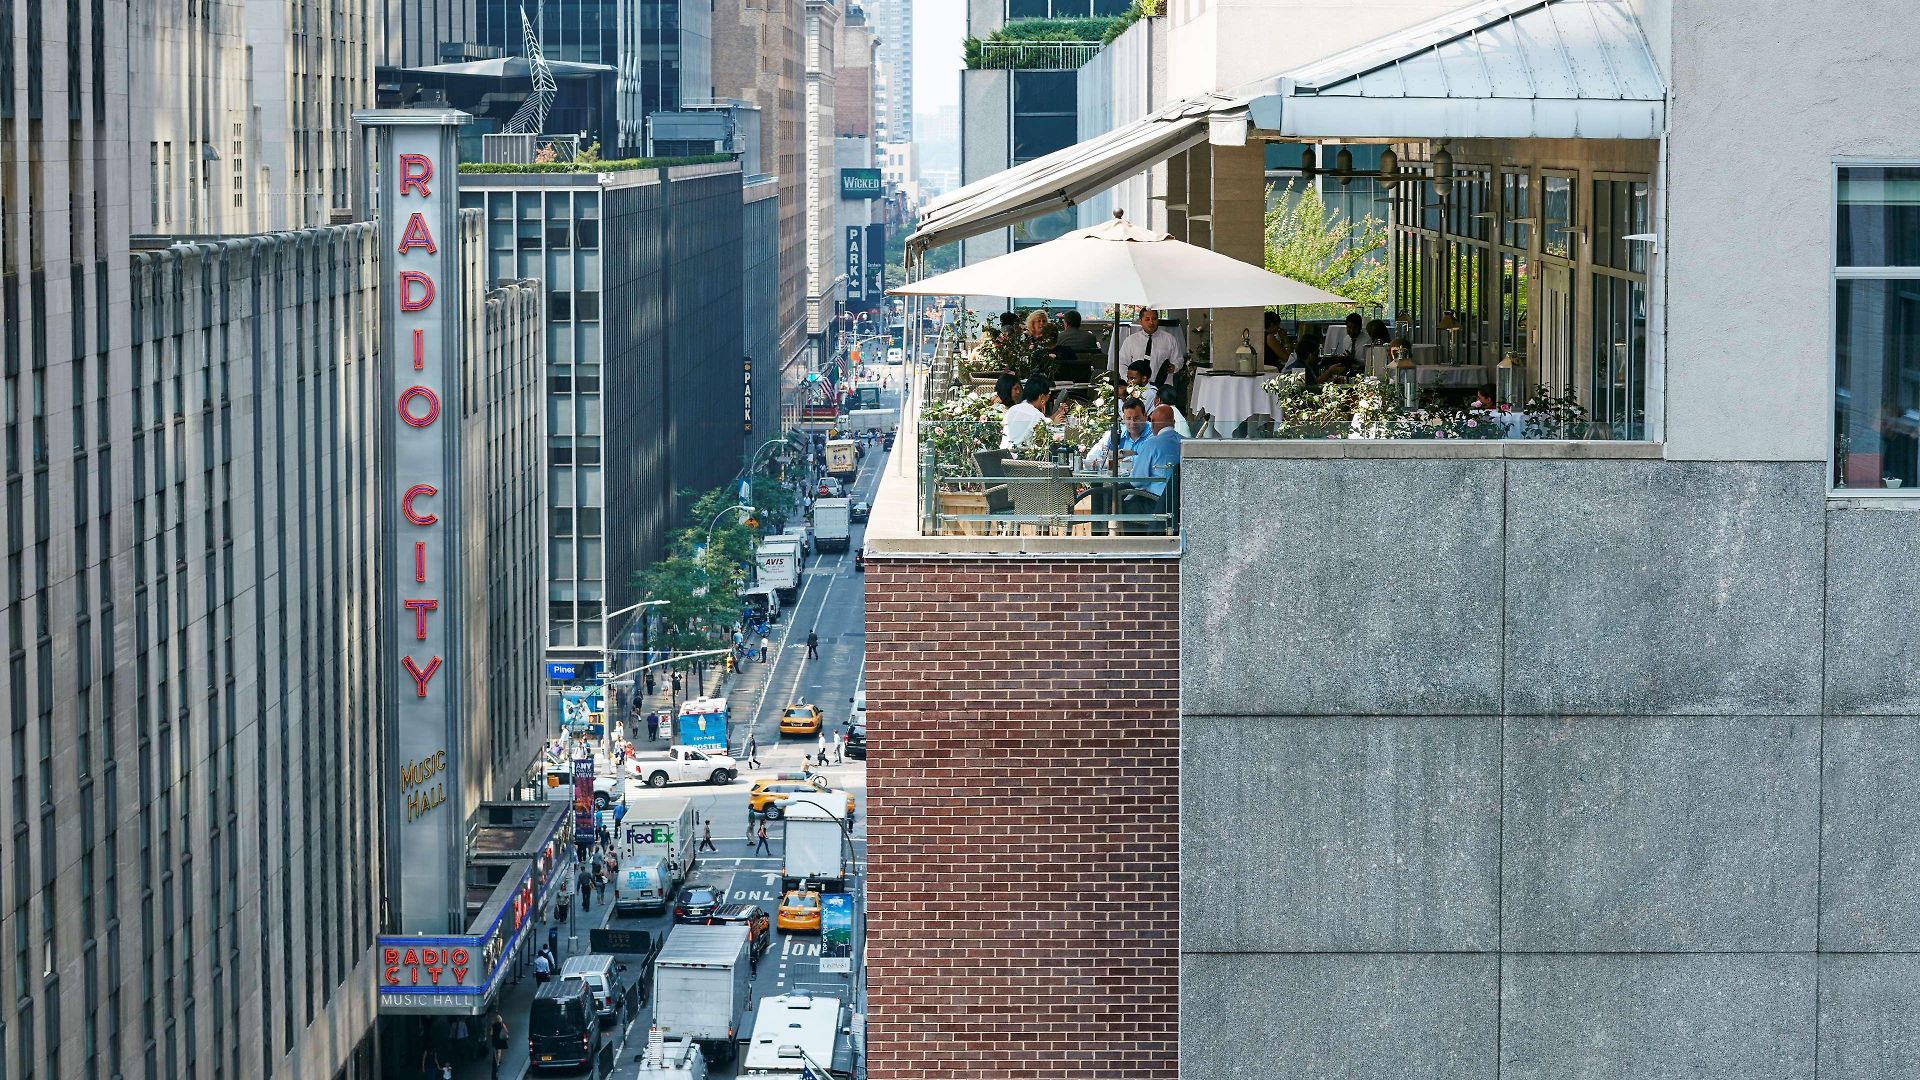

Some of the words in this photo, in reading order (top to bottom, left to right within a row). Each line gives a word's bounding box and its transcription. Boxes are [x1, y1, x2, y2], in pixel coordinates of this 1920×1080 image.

[849, 229, 859, 276] PARK
[398, 153, 440, 428] RADIO
[765, 558, 784, 566] AVIS
[401, 483, 442, 698] CITY
[400, 750, 446, 793] MUSIC
[407, 782, 446, 822] HALL
[626, 829, 674, 844] FedEx
[628, 871, 647, 879] PAR
[733, 891, 774, 901] ONL
[384, 947, 469, 966] RADIO
[385, 966, 469, 985] CITY
[381, 994, 428, 1006] MUSIC
[433, 994, 472, 1006] HALL
